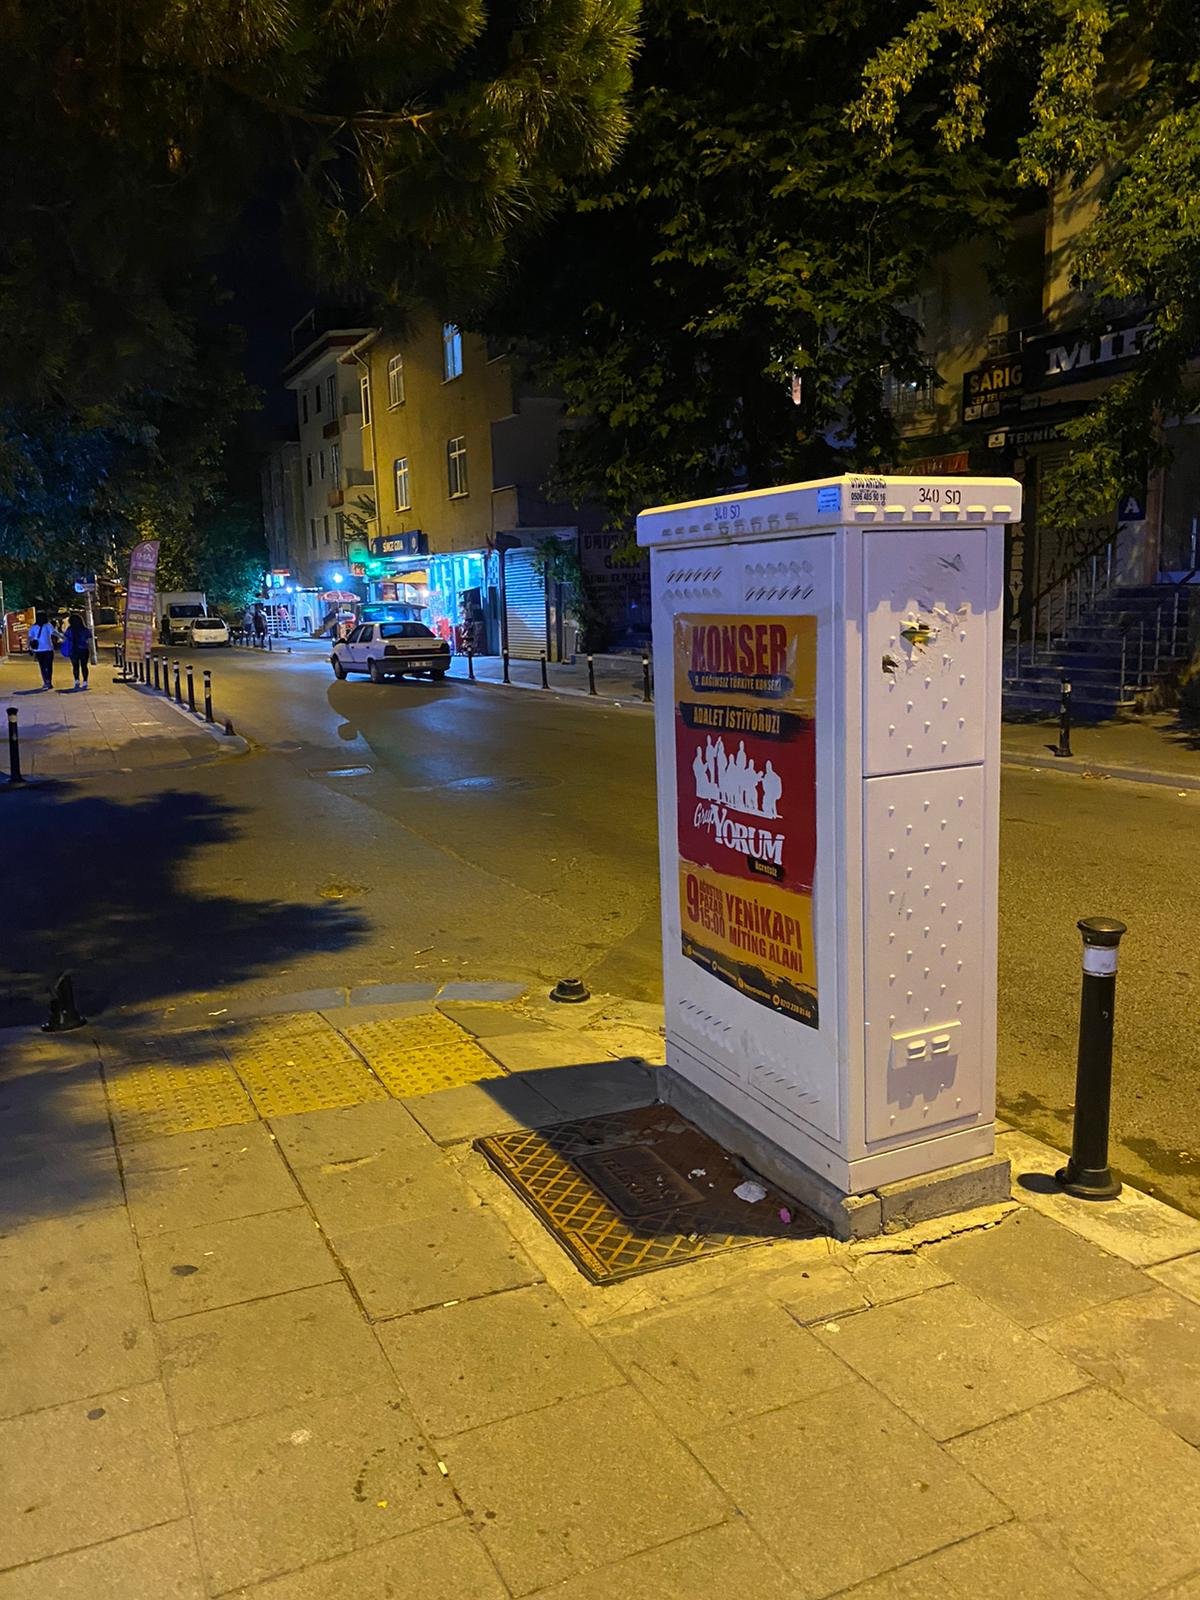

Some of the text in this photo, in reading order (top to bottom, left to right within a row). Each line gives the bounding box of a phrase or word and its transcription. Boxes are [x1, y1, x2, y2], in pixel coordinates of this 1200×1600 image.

[919, 488, 961, 505] 340 SD
[692, 624, 787, 676] KONSER
[693, 706, 780, 734] ADALET İSTİYORUZ!
[711, 803, 785, 865] YORUM
[687, 873, 699, 923] 9
[725, 893, 802, 951] YENİKAPI
[729, 925, 766, 959] MİTİNG
[768, 942, 802, 974] ALANI
